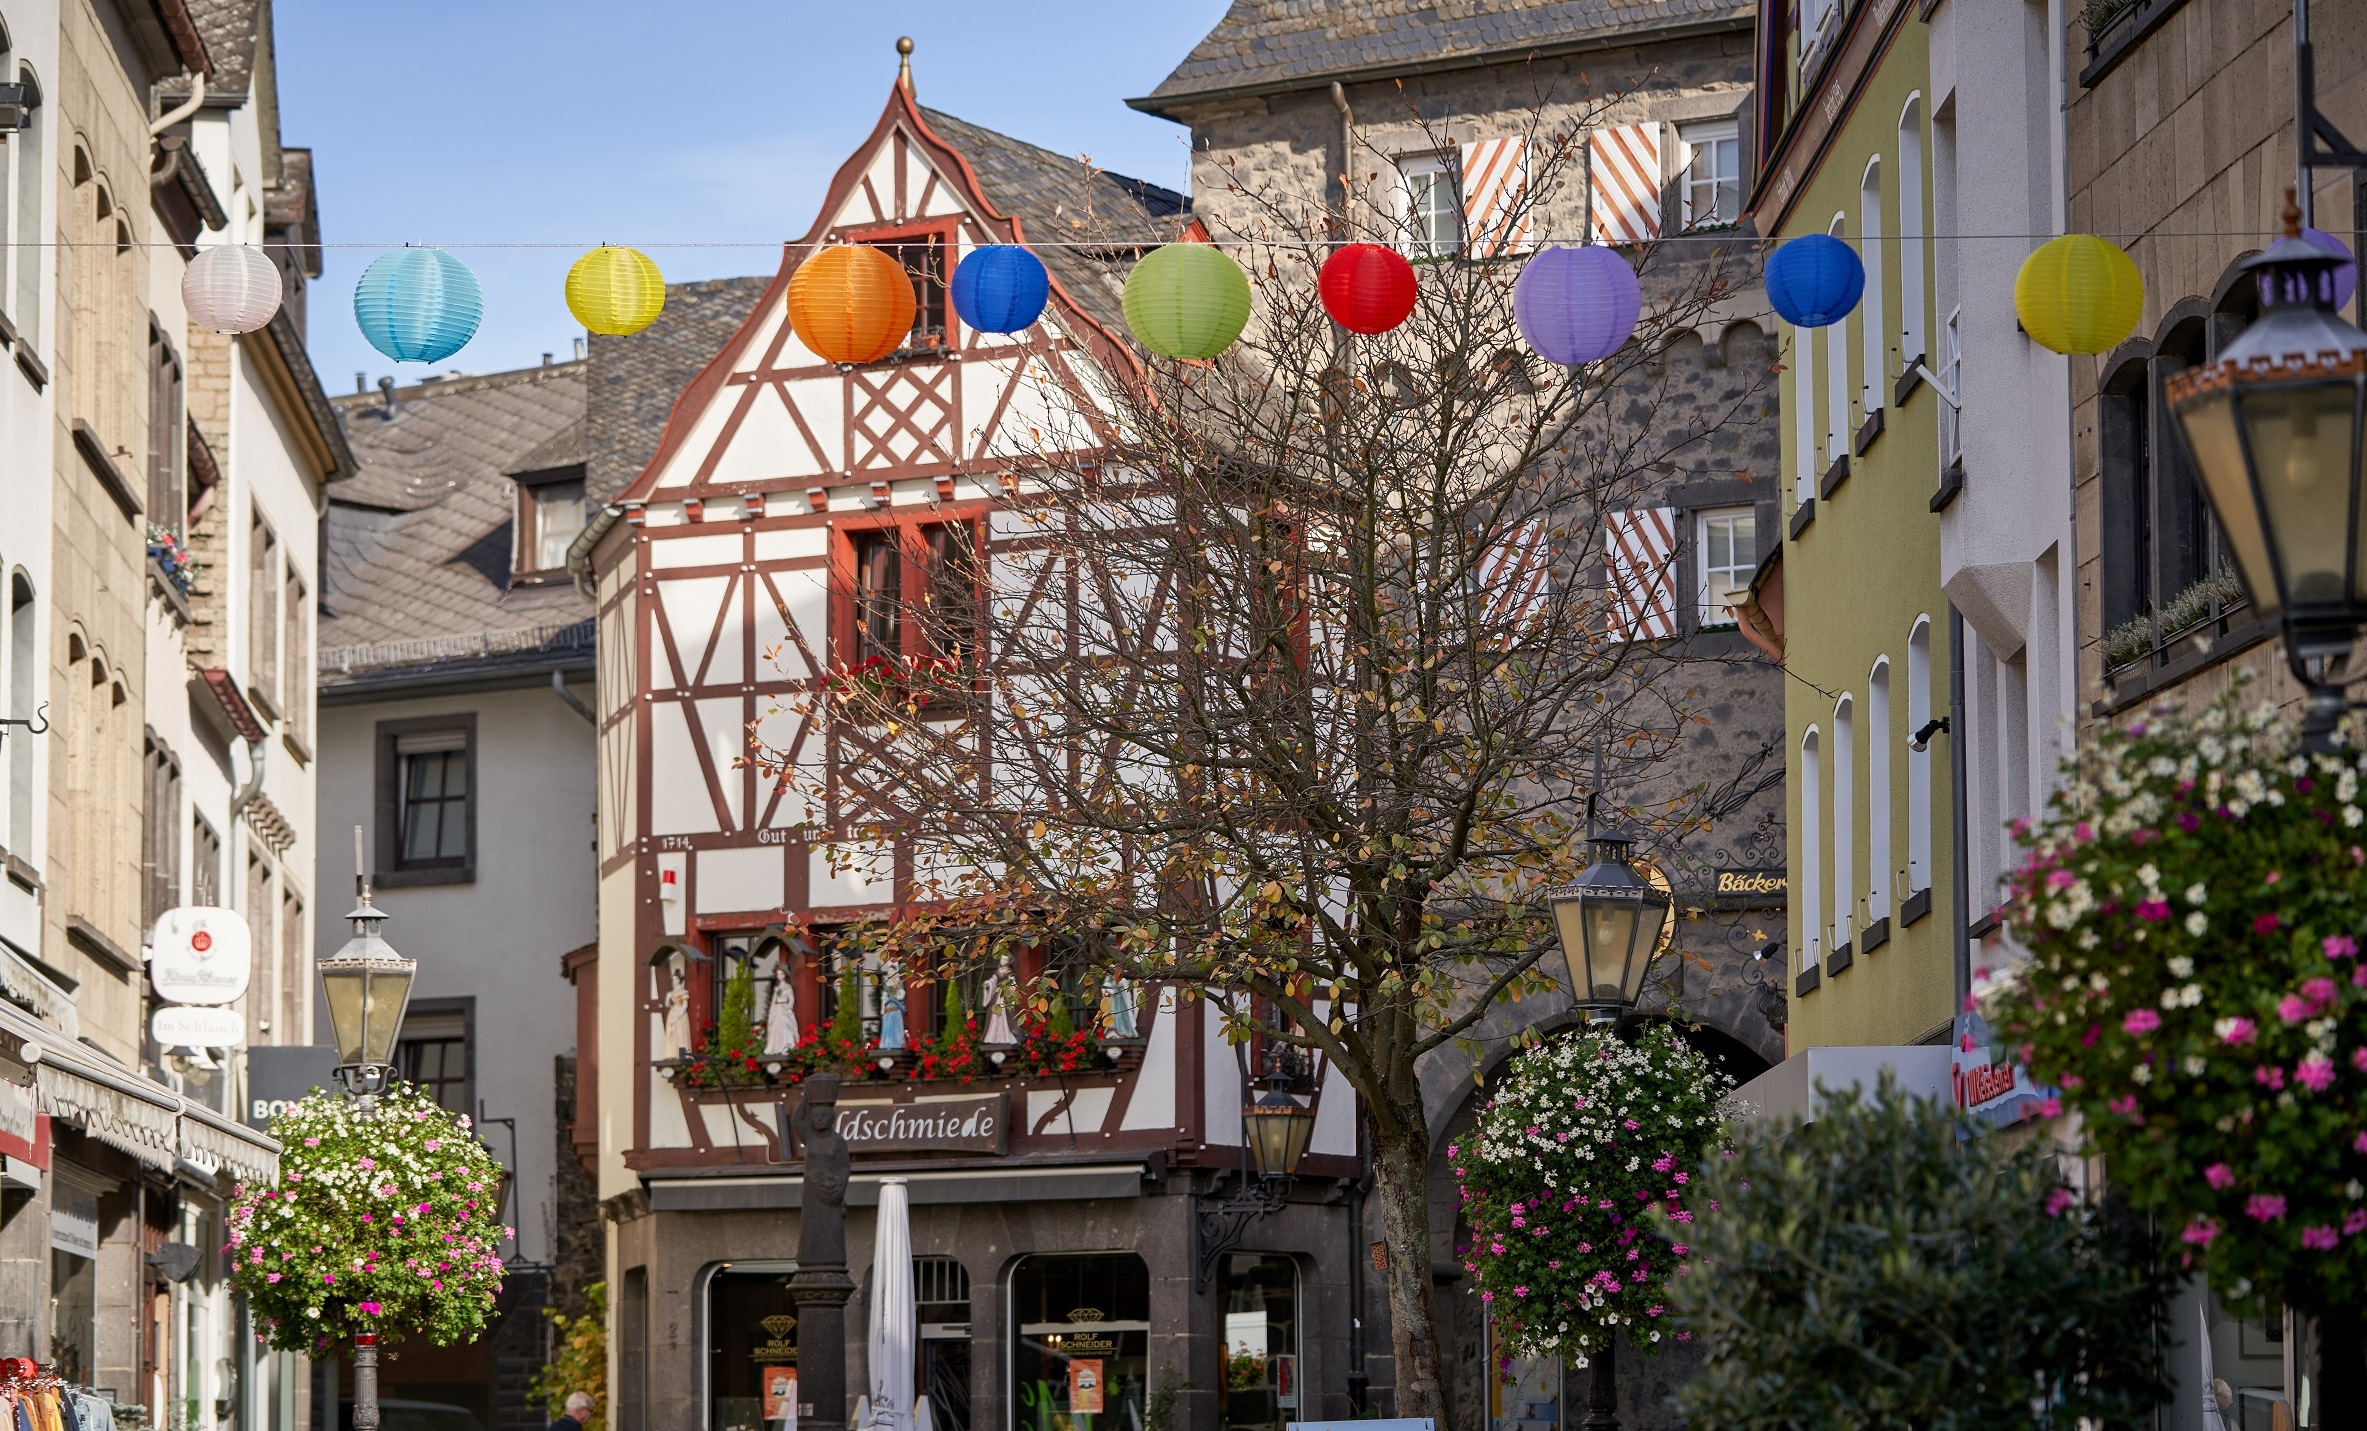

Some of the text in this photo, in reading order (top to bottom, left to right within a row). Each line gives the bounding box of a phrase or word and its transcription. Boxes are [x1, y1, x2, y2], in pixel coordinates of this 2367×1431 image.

[661, 836, 690, 849] 1714
[757, 828, 787, 844] Gut
[1717, 872, 1788, 894] Bäcker
[835, 1106, 994, 1140] ldschmiede
[1073, 1332, 1099, 1341] ROLF
[766, 1339, 792, 1347] ROLF
[1060, 1340, 1113, 1349] SCHNEIDER
[753, 1346, 798, 1356] SCHNEIDE
